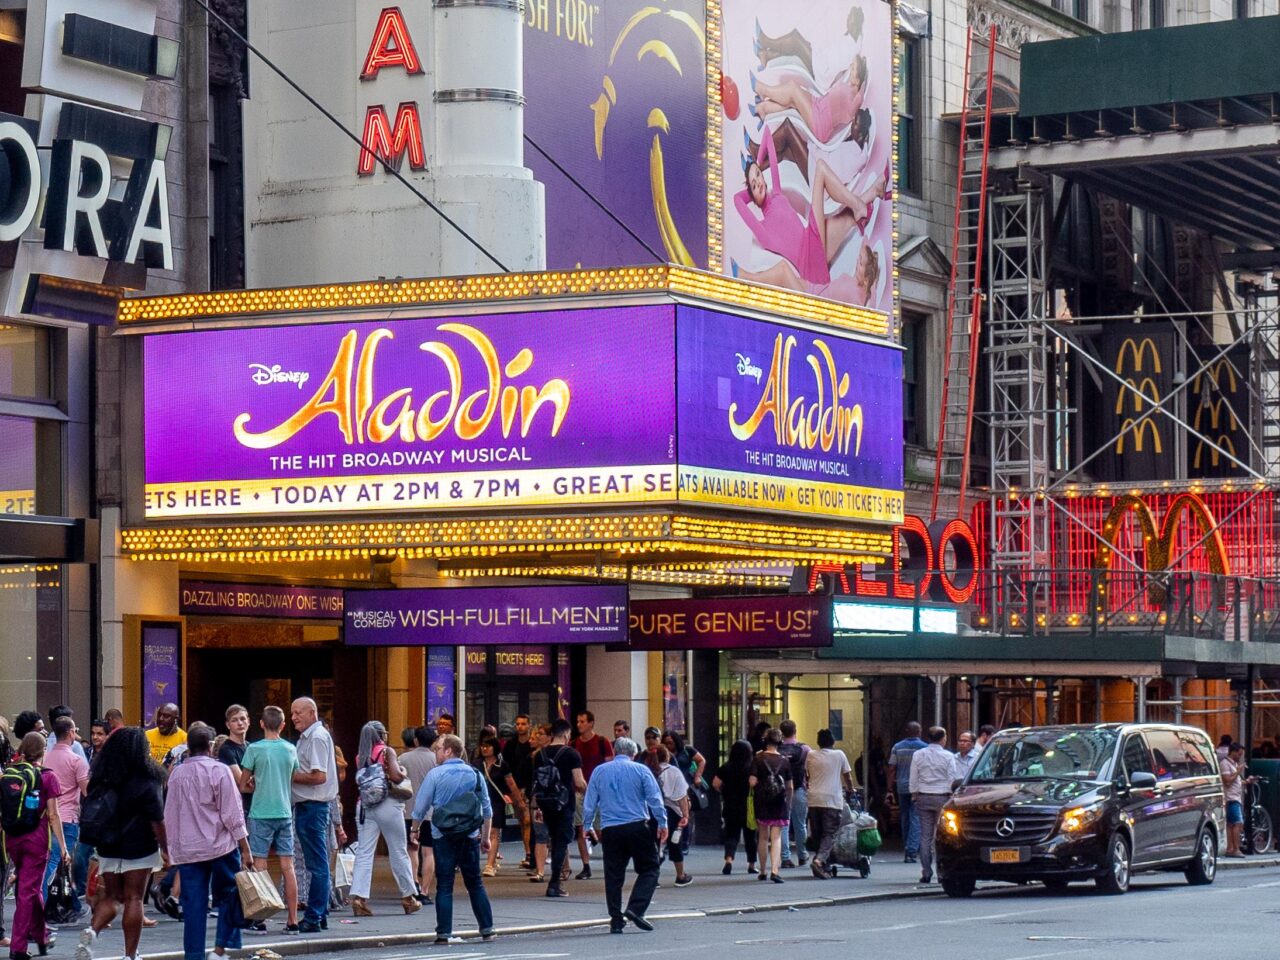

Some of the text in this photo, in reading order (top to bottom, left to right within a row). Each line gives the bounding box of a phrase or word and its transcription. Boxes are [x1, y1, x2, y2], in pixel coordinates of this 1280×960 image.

[233, 322, 570, 449] Aladdin
[729, 332, 863, 456] Aladdin
[270, 447, 531, 470] THE HIT BROADWAY MUSICAL
[745, 450, 849, 477] THE HIT BROADWAY MUSICAL
[186, 489, 242, 508] HERE
[272, 485, 347, 505] TODAY
[357, 483, 384, 502] AT
[393, 481, 439, 501] 2PM
[449, 480, 463, 499] &
[473, 478, 521, 498] 7PM
[553, 474, 634, 496] GREAT
[702, 476, 759, 500] AVAILABLE
[762, 482, 786, 503] NOW
[797, 487, 816, 506] GET
[819, 489, 844, 509] YOUR
[847, 493, 883, 514] TICKETS
[183, 590, 235, 607] DAZZLING
[237, 592, 295, 610] BROADWAY
[296, 595, 317, 610] ONE
[353, 619, 396, 628] COMEDY
[466, 652, 487, 664] YOUR
[496, 652, 523, 665] TICKETS
[525, 653, 544, 666] HERE!
